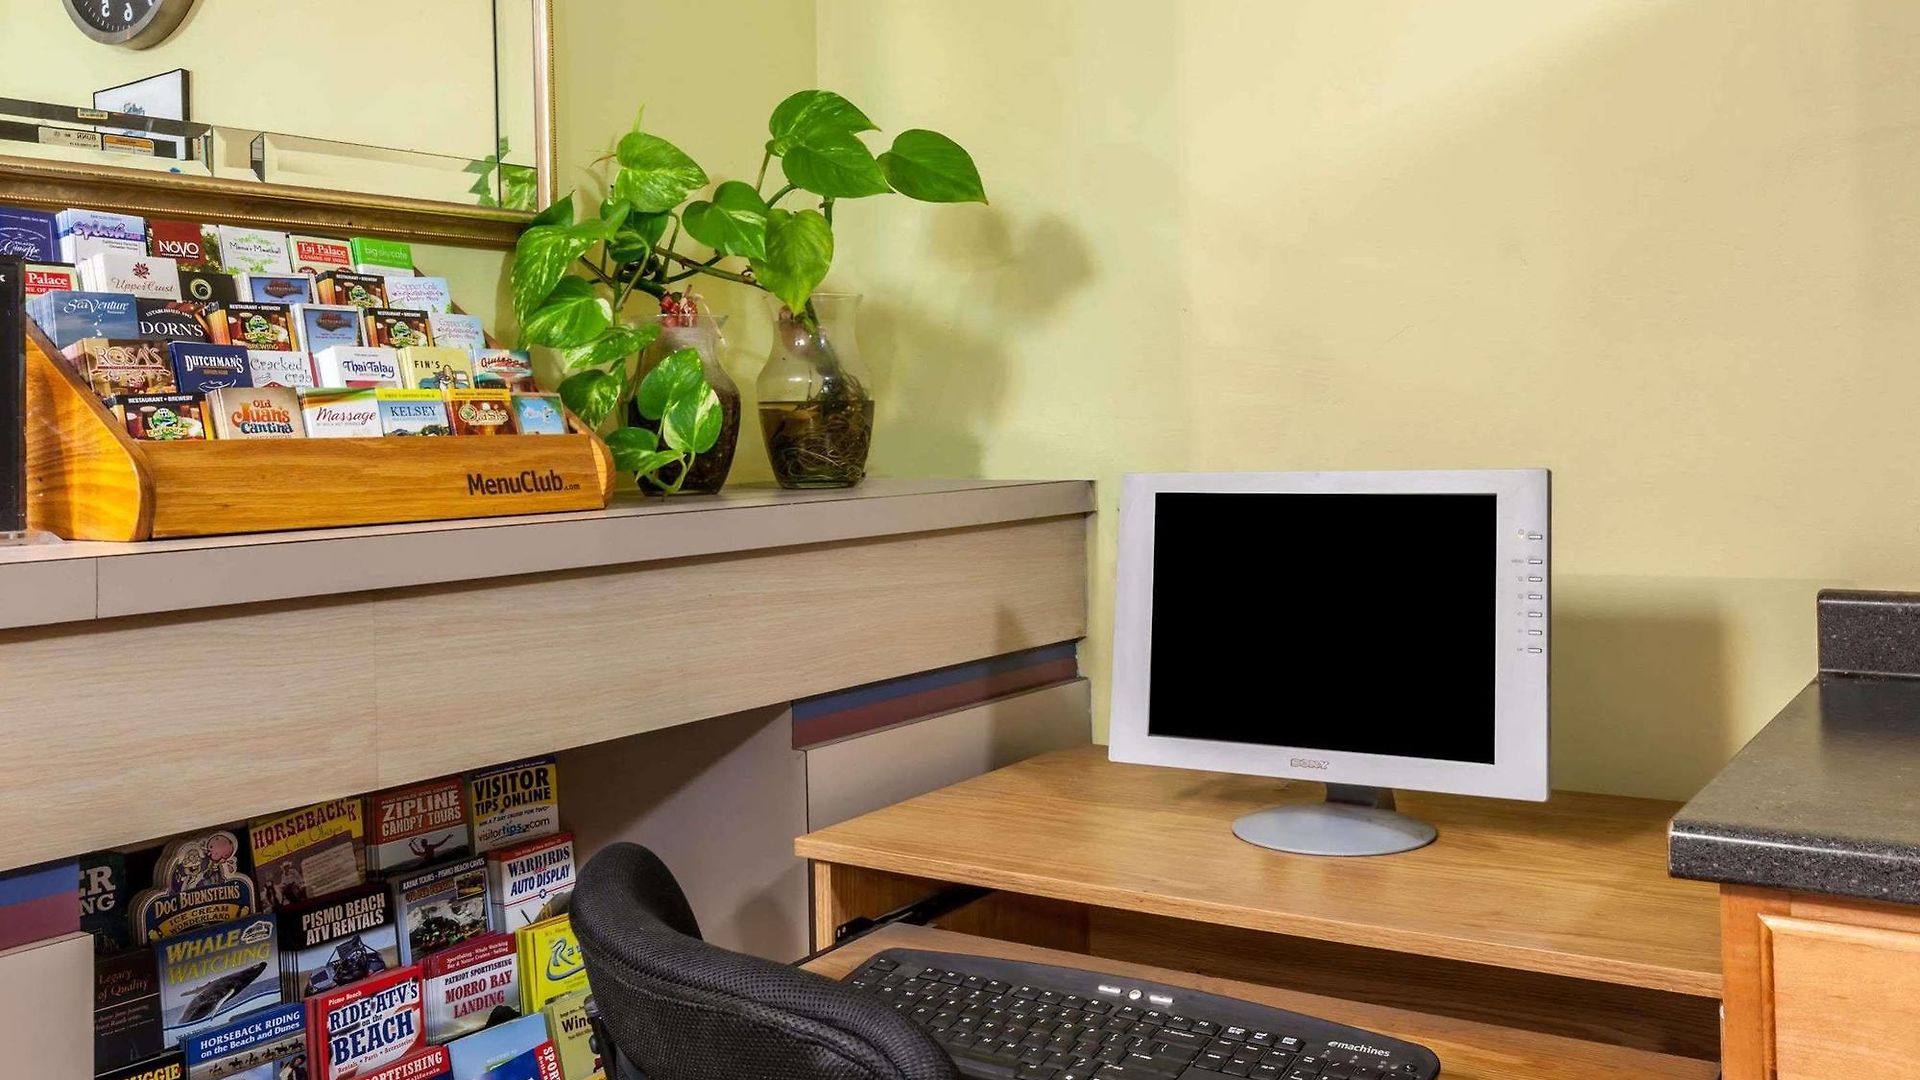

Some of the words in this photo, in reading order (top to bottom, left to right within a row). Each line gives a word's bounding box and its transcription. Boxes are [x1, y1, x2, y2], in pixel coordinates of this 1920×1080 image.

[298, 242, 316, 255] Taj
[317, 244, 346, 257] Palace
[28, 272, 68, 286] Palace
[139, 321, 204, 337] DORN'S
[184, 354, 244, 374] DUTCHMAN'S
[414, 360, 441, 369] FIN'S
[231, 402, 290, 428] Juan's
[253, 399, 272, 409] Old
[316, 406, 377, 426] Massage
[390, 405, 437, 418] KELSEY
[241, 421, 294, 435] Cantina
[1290, 758, 1330, 770] SONY
[473, 767, 550, 802] VISITOR
[382, 789, 459, 823] ZIPLINE
[474, 799, 499, 817] TIPS
[502, 786, 552, 809] ONLINE
[252, 799, 347, 850] HORSEBACK
[382, 814, 424, 837] CANOPY
[427, 805, 462, 826] TOURS
[419, 873, 435, 885] TOURS
[438, 868, 454, 879] PISMO
[454, 863, 471, 874] BEACH
[507, 845, 571, 878] WARBIRDS
[510, 877, 535, 897] AUTO
[536, 864, 571, 889] DISPLAY
[153, 898, 178, 919] DOC
[169, 912, 187, 927] ICE
[191, 904, 230, 918] CREAM
[302, 905, 344, 932] PISMO
[345, 892, 386, 918] BEACH
[169, 914, 231, 935] WONDERLAND
[306, 923, 331, 946] ATV
[332, 908, 385, 939] RENTALS
[165, 928, 241, 965] WHALE
[167, 942, 272, 986] WATCHING
[444, 971, 470, 986] PATRIOT
[470, 958, 513, 977] SPORTFISHING
[328, 996, 346, 1006] Pismo
[346, 990, 362, 1001] Beach
[445, 977, 487, 1005] MORRO
[489, 969, 513, 989] BAY
[329, 998, 371, 1032] RIDE
[453, 990, 505, 1020] LANDING
[200, 1022, 263, 1051] HORSEBACK
[265, 1010, 301, 1029] RIDING
[361, 1019, 371, 1028] on
[372, 1013, 383, 1023] the
[200, 1050, 213, 1059] on
[214, 1044, 229, 1055] the
[229, 1034, 256, 1050] Beach
[257, 1028, 273, 1041] and
[274, 1021, 301, 1035] Dunes
[332, 1009, 414, 1067] BEACH
[1327, 1040, 1391, 1058] emachines
[542, 1045, 561, 1080] SPOR
